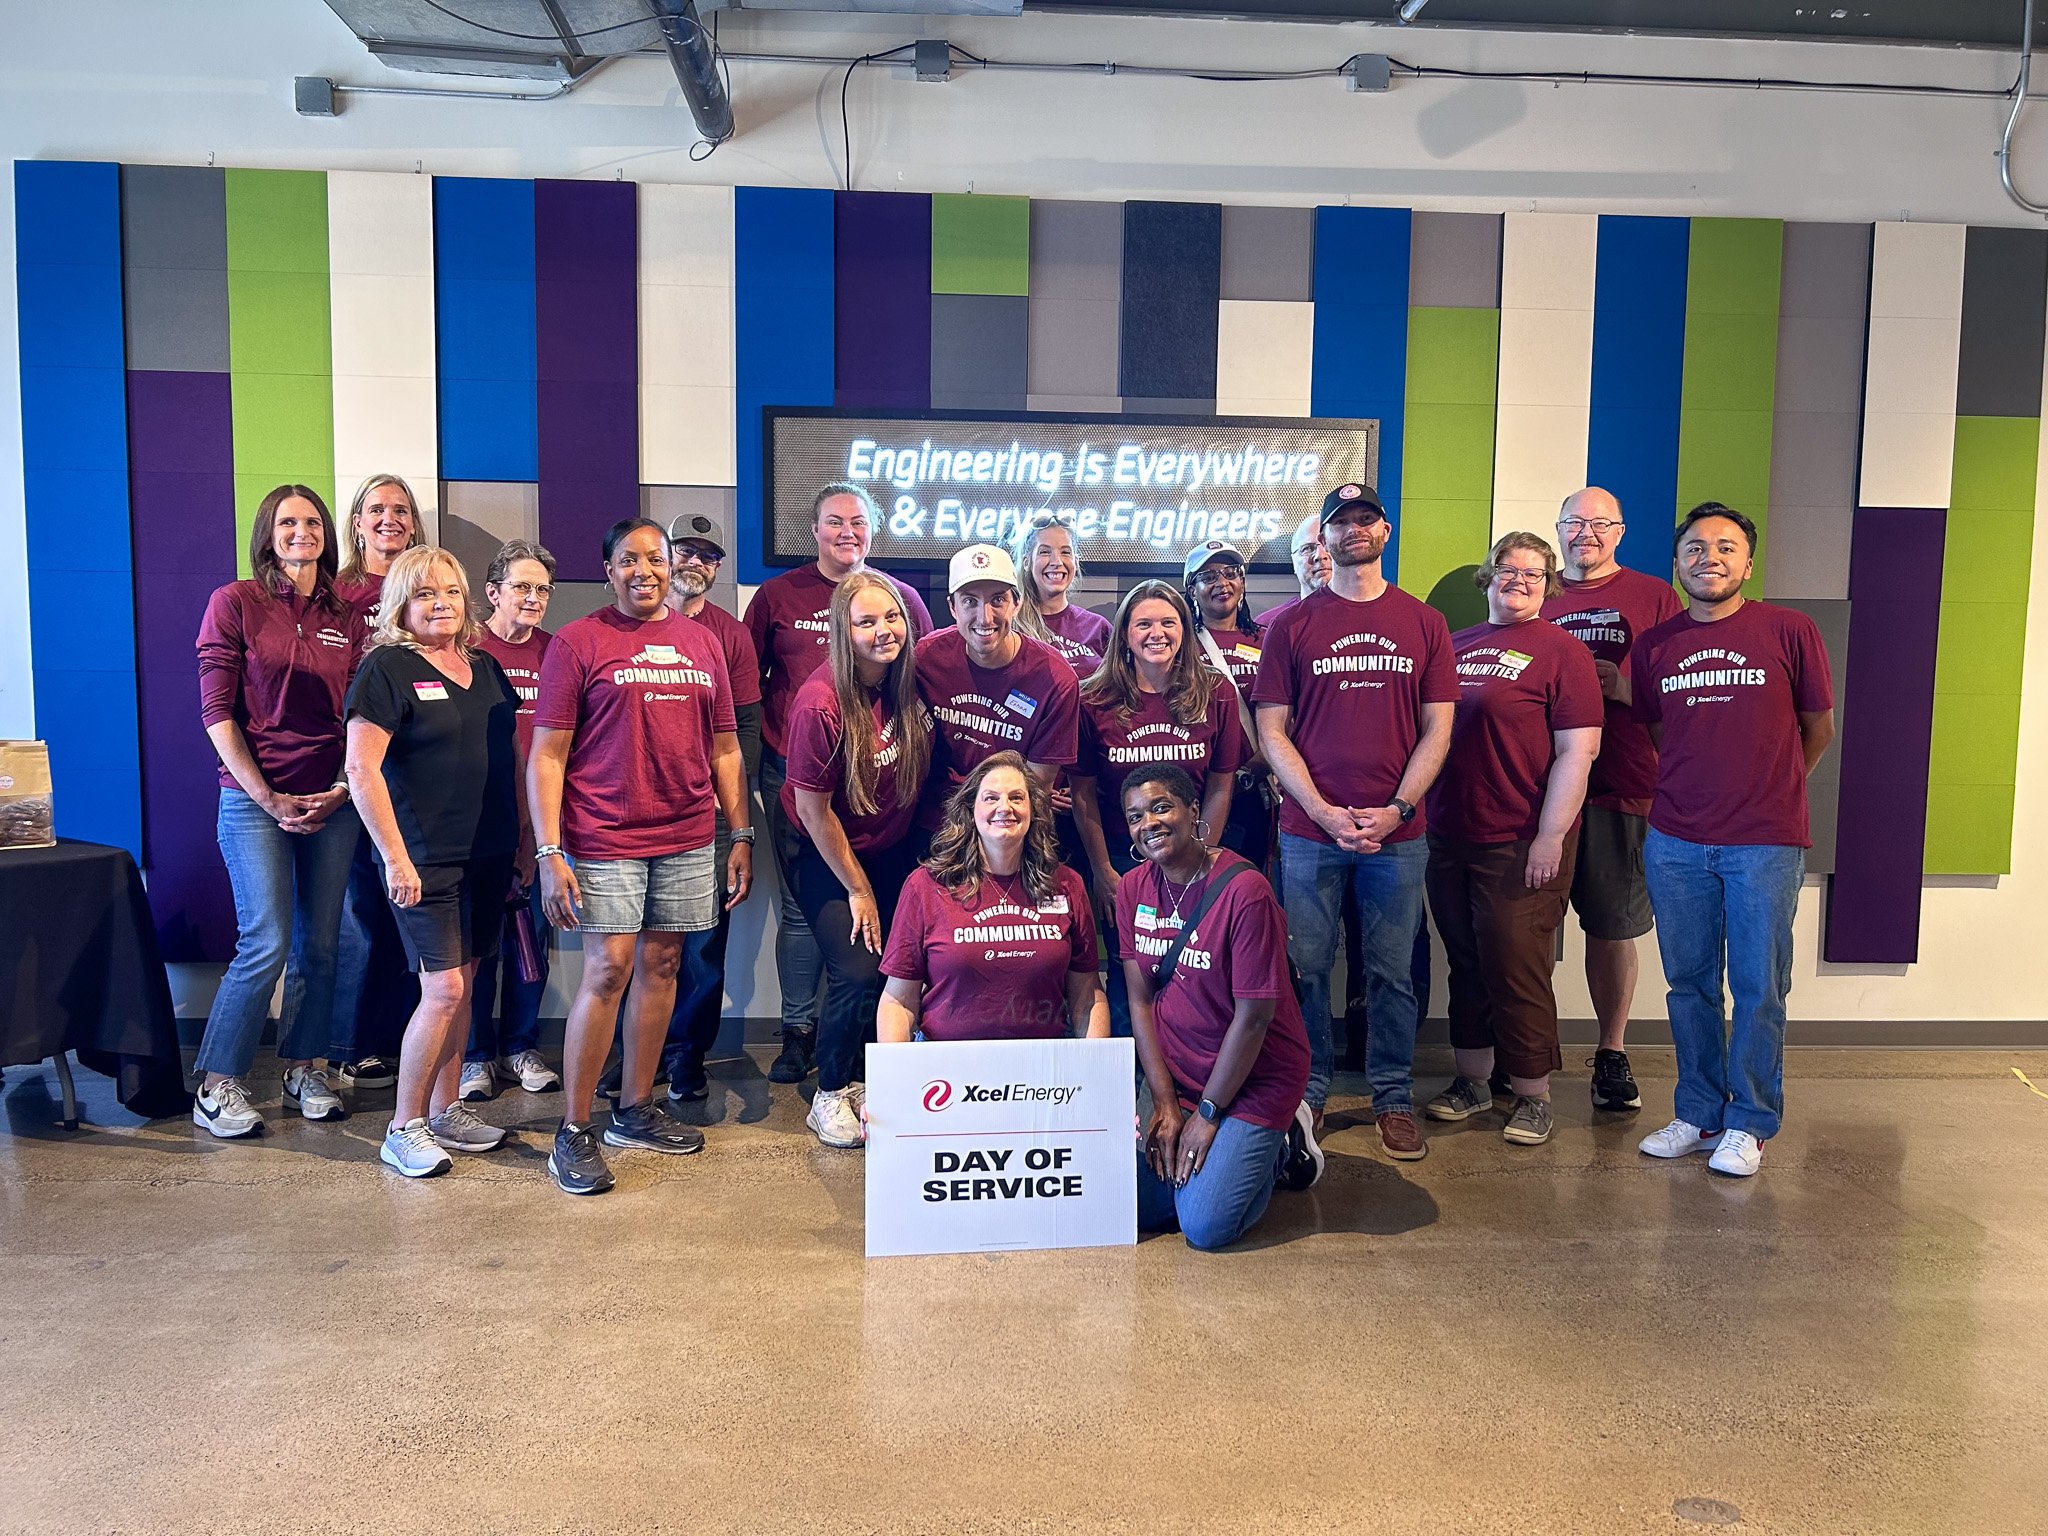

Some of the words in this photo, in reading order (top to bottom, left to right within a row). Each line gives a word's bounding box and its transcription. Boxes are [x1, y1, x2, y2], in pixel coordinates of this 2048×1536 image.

[848, 437, 1063, 491] Engineering
[1113, 443, 1320, 492] Everywhere
[889, 495, 927, 537] &
[1106, 499, 1283, 548] Engineers
[1330, 633, 1377, 652] POWERING
[1378, 636, 1398, 652] OUR
[1312, 654, 1414, 676] COMMUNITIES
[1461, 648, 1500, 661] POWERING
[1678, 648, 1725, 671] POWERING
[1726, 651, 1747, 666] OUR
[503, 669, 530, 677] ERING
[614, 668, 713, 688] COMMUNITIES
[1661, 669, 1765, 693] COMMUNITIES
[950, 693, 993, 707] POWERING
[992, 702, 1010, 720] OUR
[933, 705, 1023, 741] COMMUNITIES
[1126, 723, 1171, 743] POWERING
[1172, 726, 1191, 741] OUR
[1108, 742, 1206, 763] COMMUNITIES
[972, 904, 1020, 923] POWERING
[1021, 907, 1041, 922] OUR
[953, 924, 1062, 943] COMMUNITIES
[961, 1084, 1010, 1102] Xcel
[934, 1150, 1014, 1173] DAY
[1024, 1148, 1072, 1170] OF
[923, 1175, 1083, 1202] SERVICE
